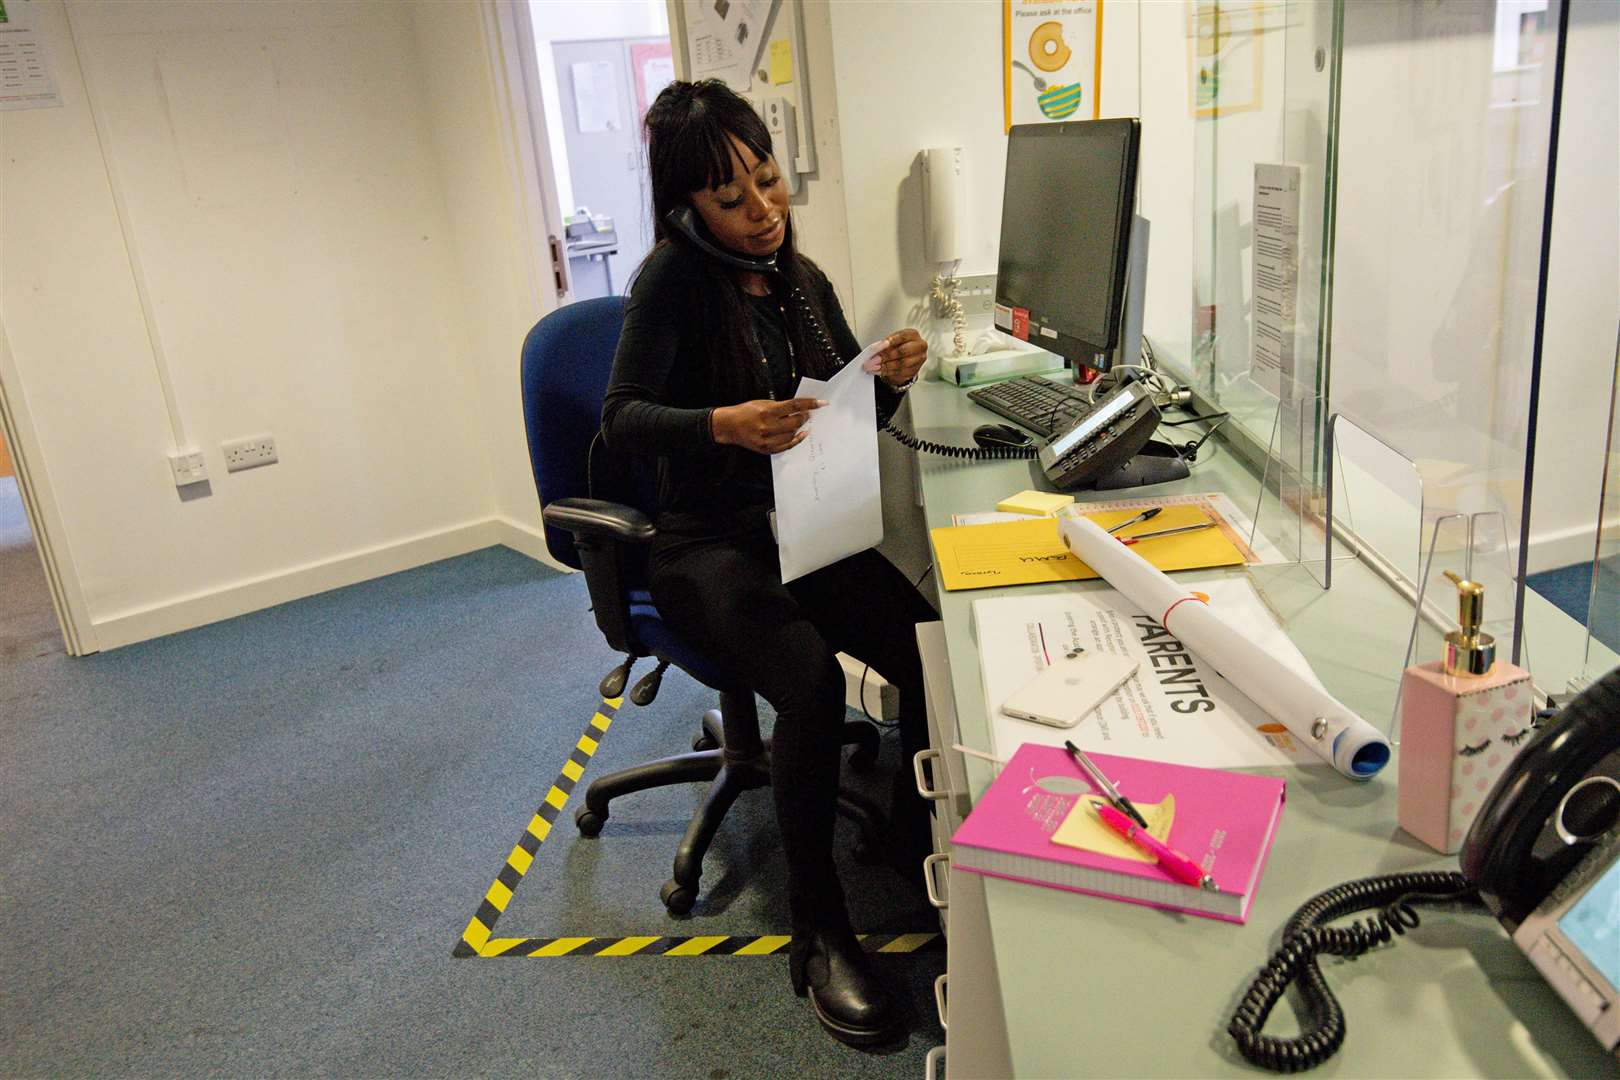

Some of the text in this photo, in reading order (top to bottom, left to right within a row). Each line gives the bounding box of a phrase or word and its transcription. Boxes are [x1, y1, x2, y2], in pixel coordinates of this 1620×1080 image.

[1039, 8, 1052, 16] ask
[1053, 8, 1061, 16] at
[1061, 7, 1073, 15] the
[1073, 7, 1092, 15] office
